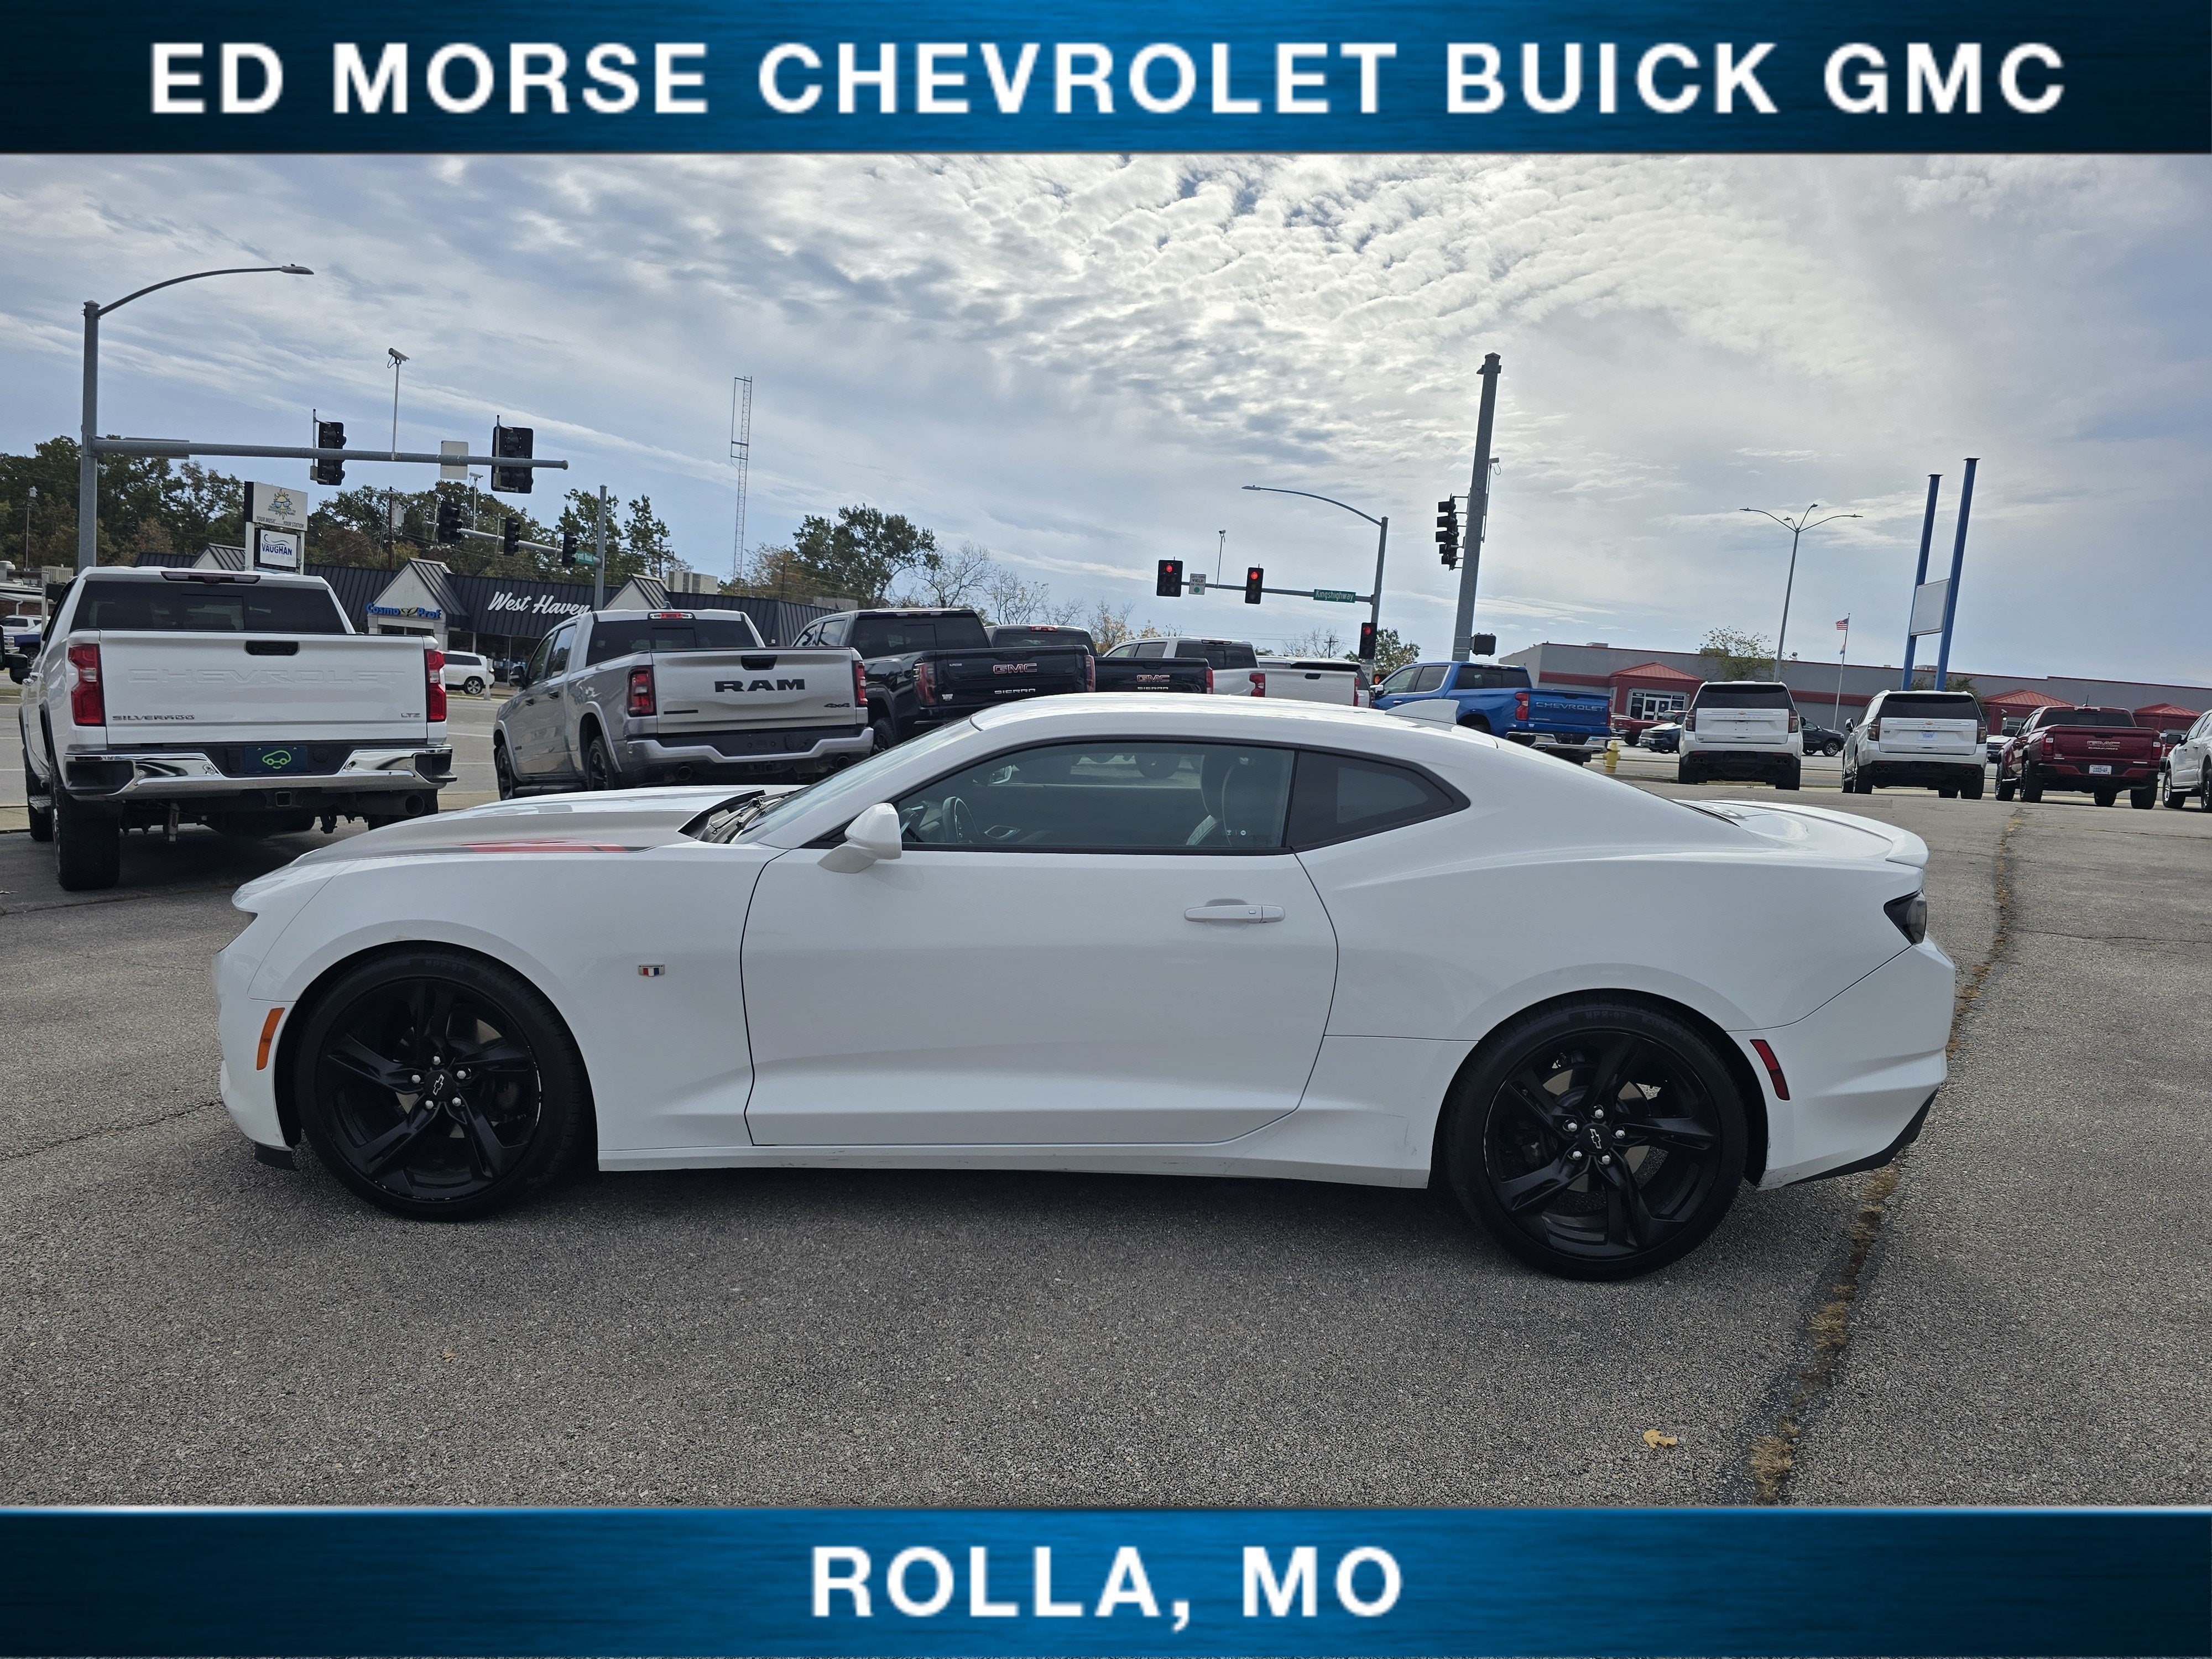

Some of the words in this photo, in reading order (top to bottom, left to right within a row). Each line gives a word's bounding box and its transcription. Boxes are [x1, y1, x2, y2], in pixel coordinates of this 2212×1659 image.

[262, 542, 292, 556] VAUGHAN
[1316, 589, 1354, 602] Kingshighway
[487, 591, 533, 612] West
[532, 594, 592, 615] Haven
[366, 602, 400, 615] Cosmo
[417, 607, 442, 619] Prof
[993, 663, 1037, 674] GMC
[128, 669, 406, 684] CHEVROLET
[1136, 674, 1170, 682] GMC
[714, 679, 805, 692] RAM
[1536, 702, 1605, 712] CHEVROLET
